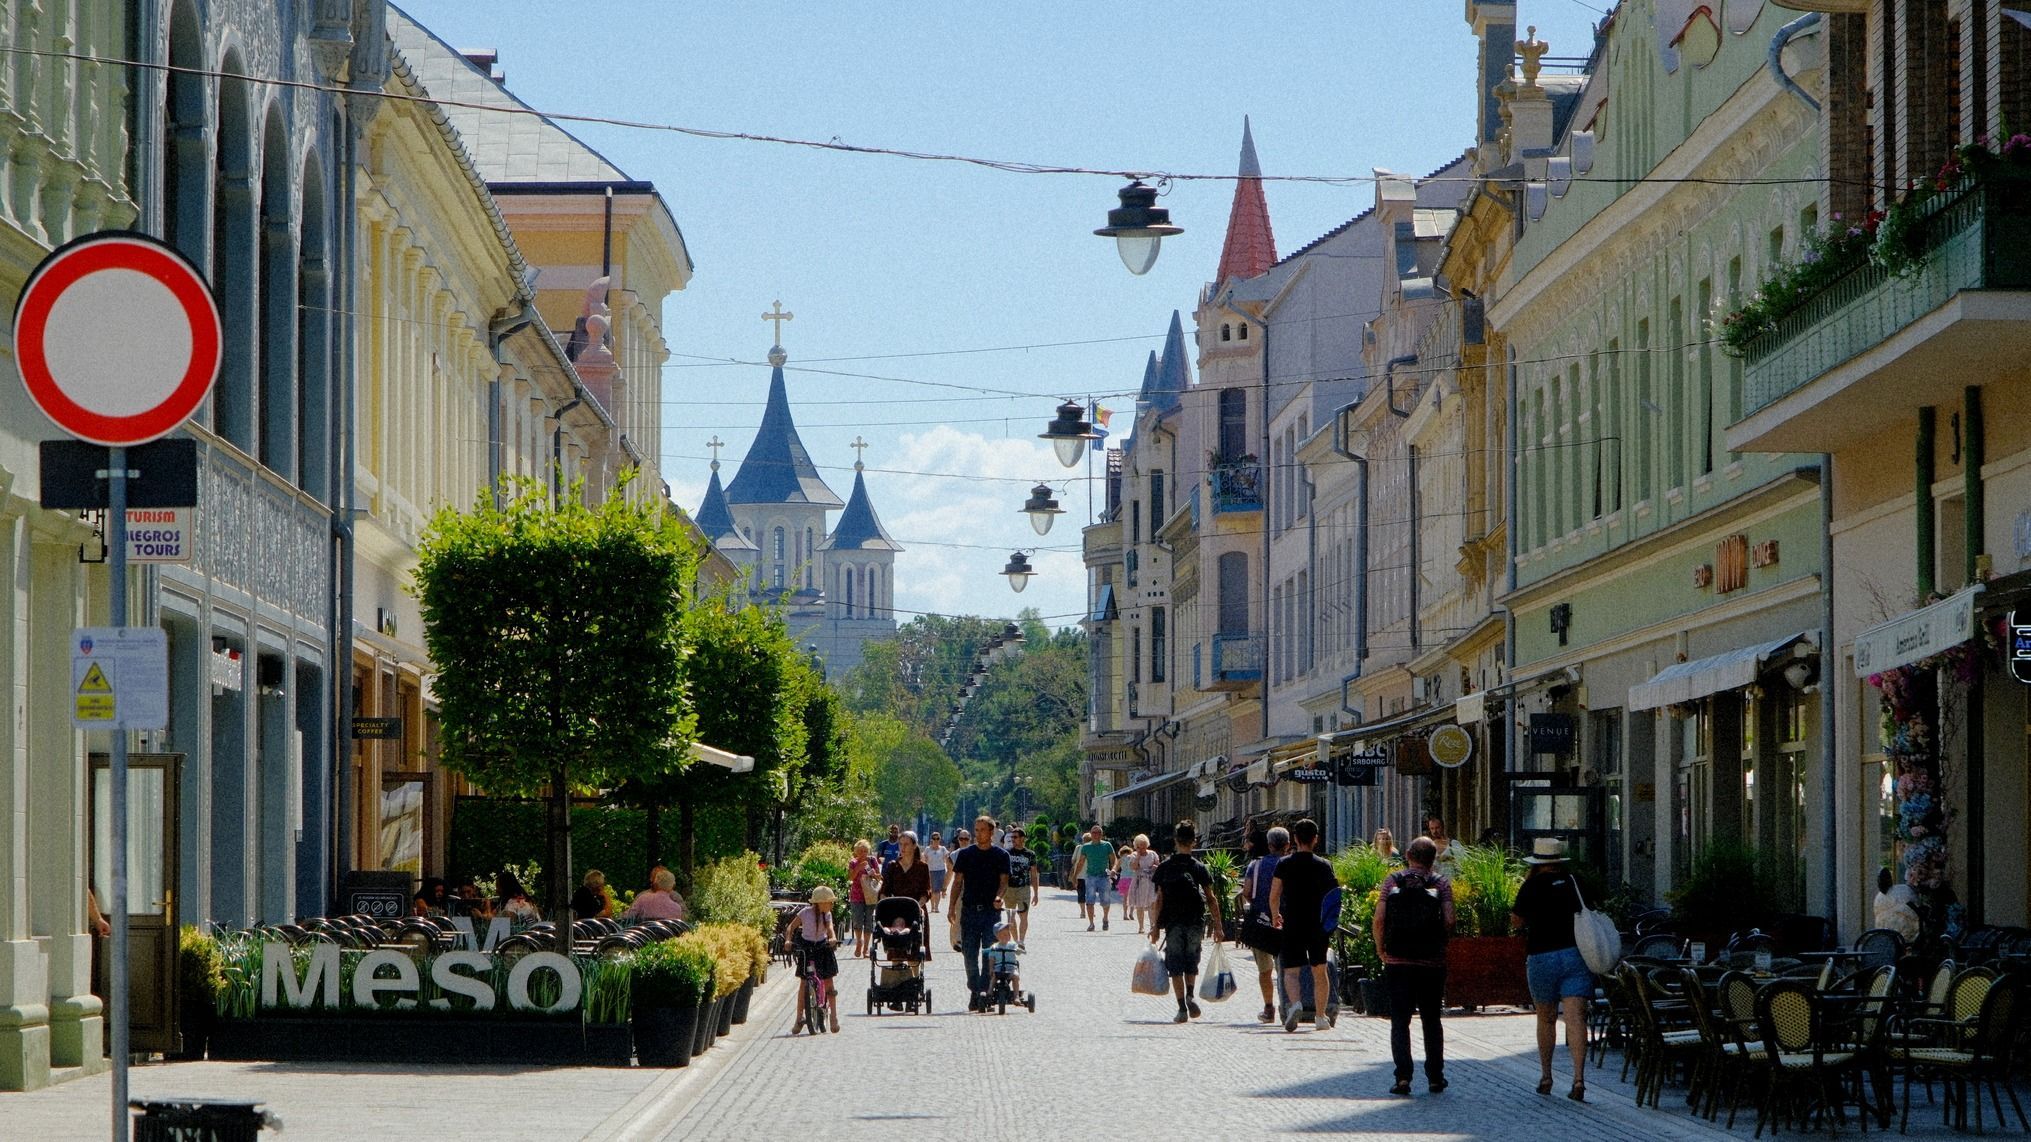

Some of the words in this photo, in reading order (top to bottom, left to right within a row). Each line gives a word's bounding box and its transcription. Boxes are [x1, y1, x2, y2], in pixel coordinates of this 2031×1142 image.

[125, 511, 176, 523] TURISM
[126, 530, 180, 542] LEGROS
[134, 544, 181, 556] TOURS
[1532, 727, 1569, 736] VENUE
[261, 942, 583, 1011] Meso
